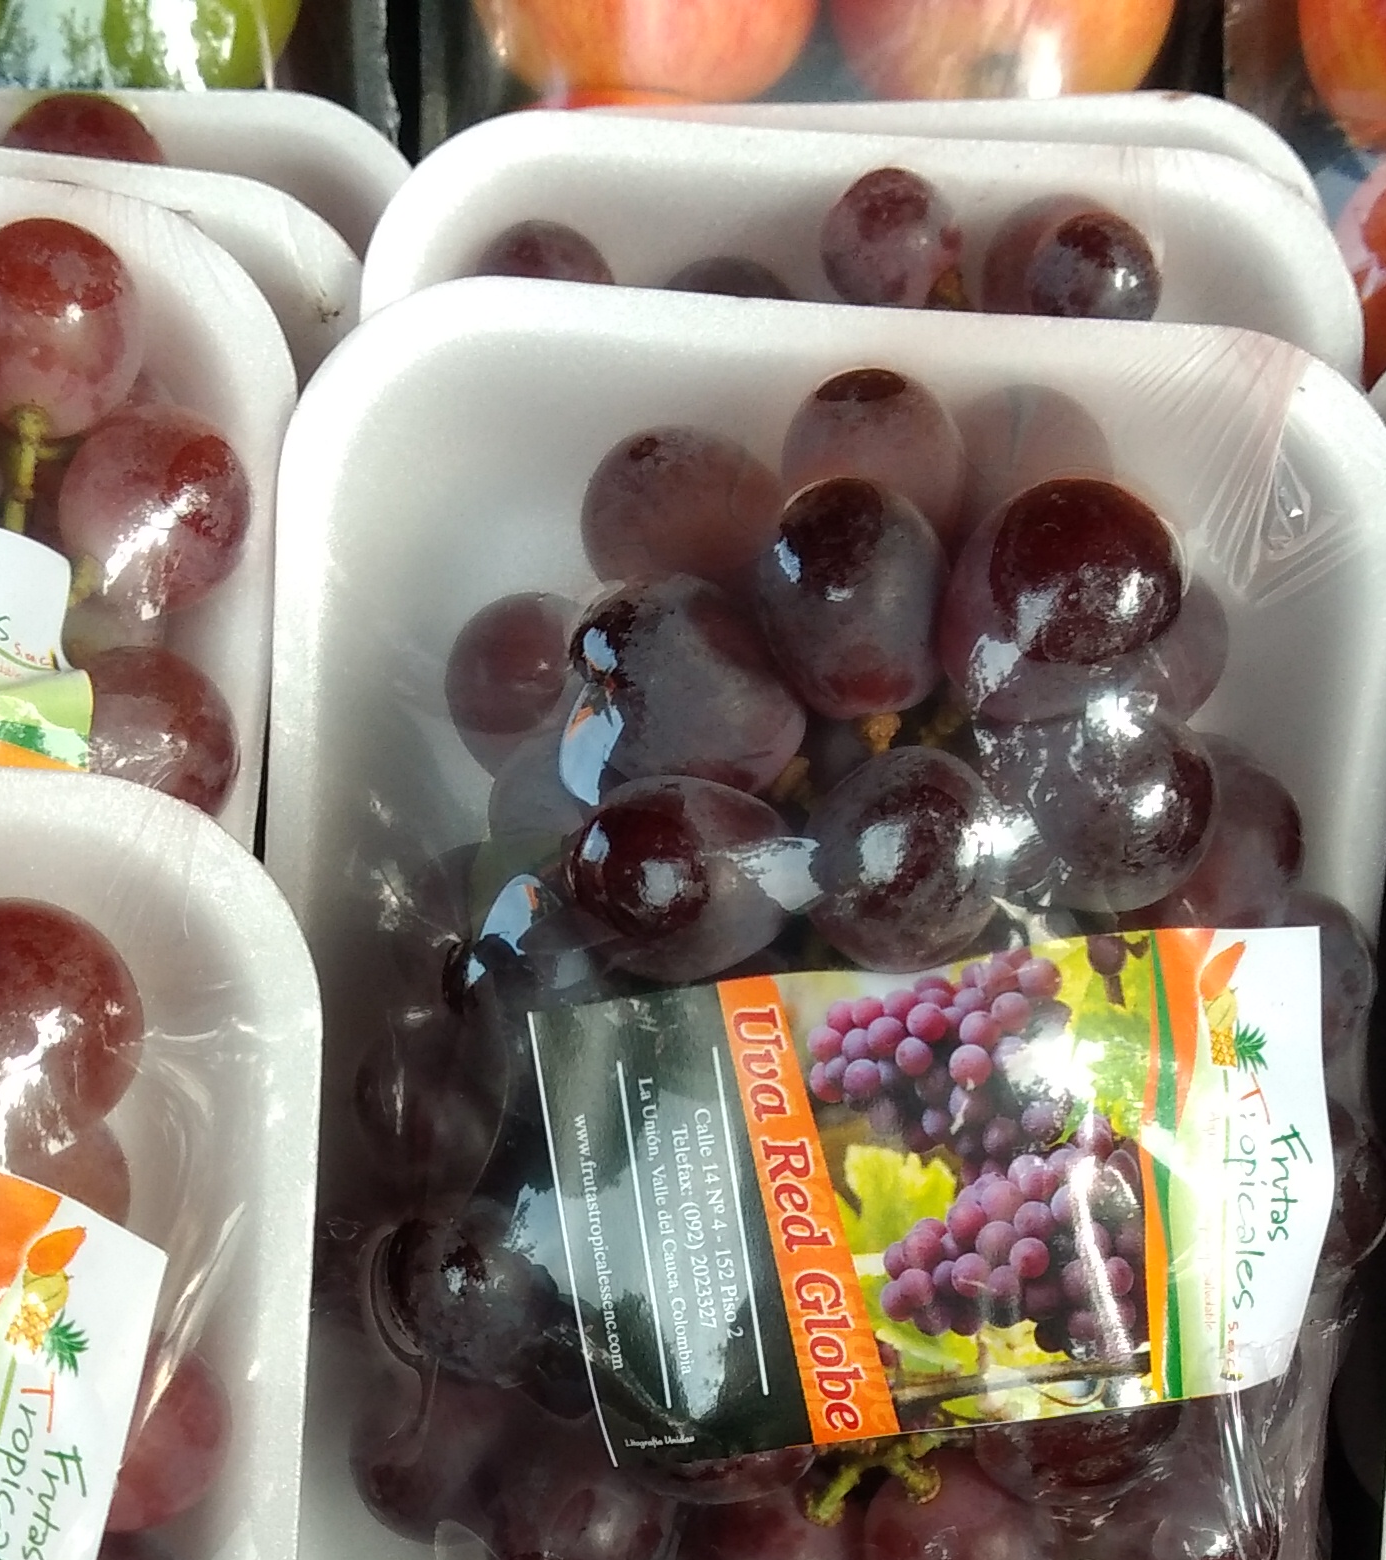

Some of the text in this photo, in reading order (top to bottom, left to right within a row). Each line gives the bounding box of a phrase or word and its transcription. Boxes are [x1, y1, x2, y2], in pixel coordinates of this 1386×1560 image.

[694, 1107, 716, 1157] Calle
[702, 1165, 720, 1184] 14
[1267, 1124, 1313, 1241] Frutas
[574, 1113, 623, 1370] www.frutastropicalessenc.com
[638, 1076, 694, 1374] La Unión, Valle del Cauca, Colombia
[672, 1123, 718, 1329] Telefax: (092) 2023327
[711, 1219, 728, 1231] 4
[732, 1006, 867, 1433] Uva Red Globe
[715, 1249, 735, 1280] 152
[720, 1284, 740, 1323] Piso
[727, 1326, 744, 1339] 2
